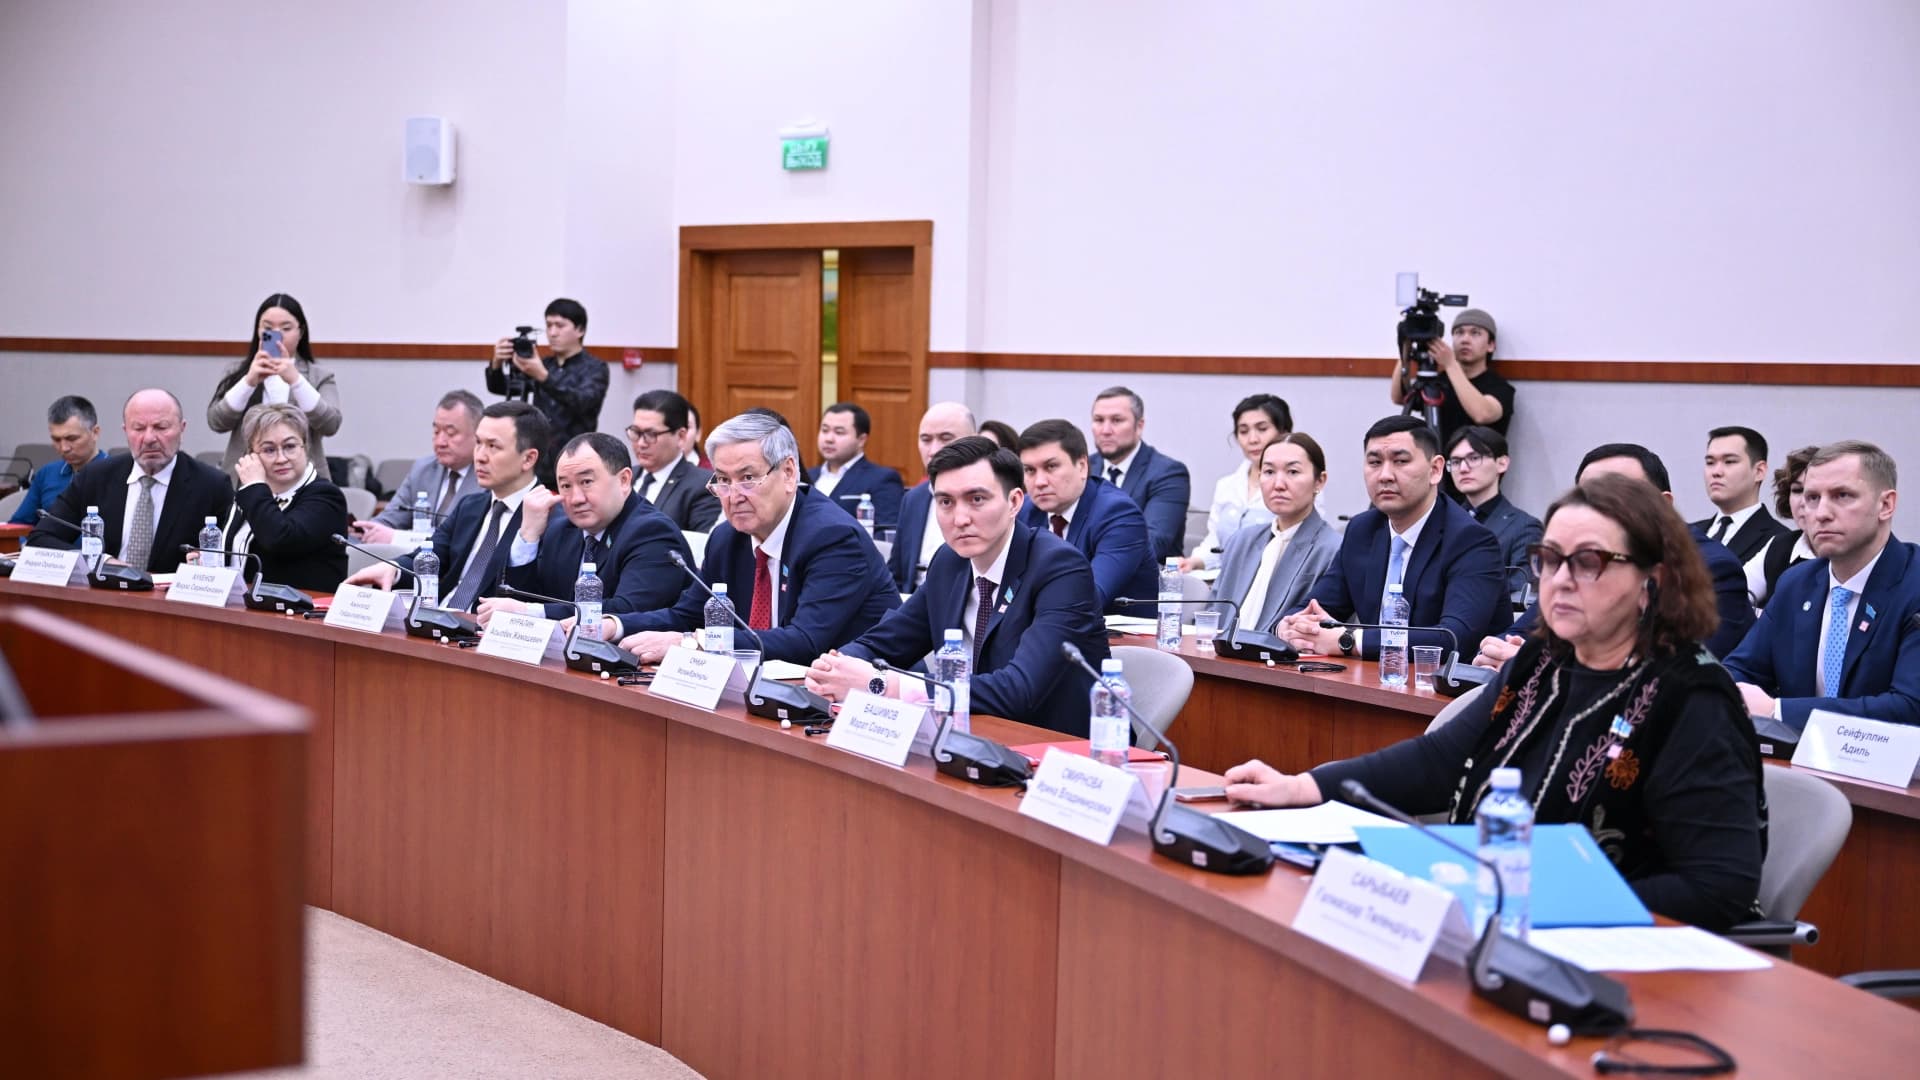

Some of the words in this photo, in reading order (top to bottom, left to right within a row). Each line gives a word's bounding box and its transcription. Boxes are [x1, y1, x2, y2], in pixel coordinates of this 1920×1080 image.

[863, 703, 899, 720] БАШИМОВ
[850, 717, 869, 730] Марат
[1837, 725, 1890, 743] Сейфуллин
[1840, 743, 1870, 757] Адиль
[1061, 767, 1105, 789] СМИРНОВА
[1351, 872, 1412, 906] САРЫБАЕВ
